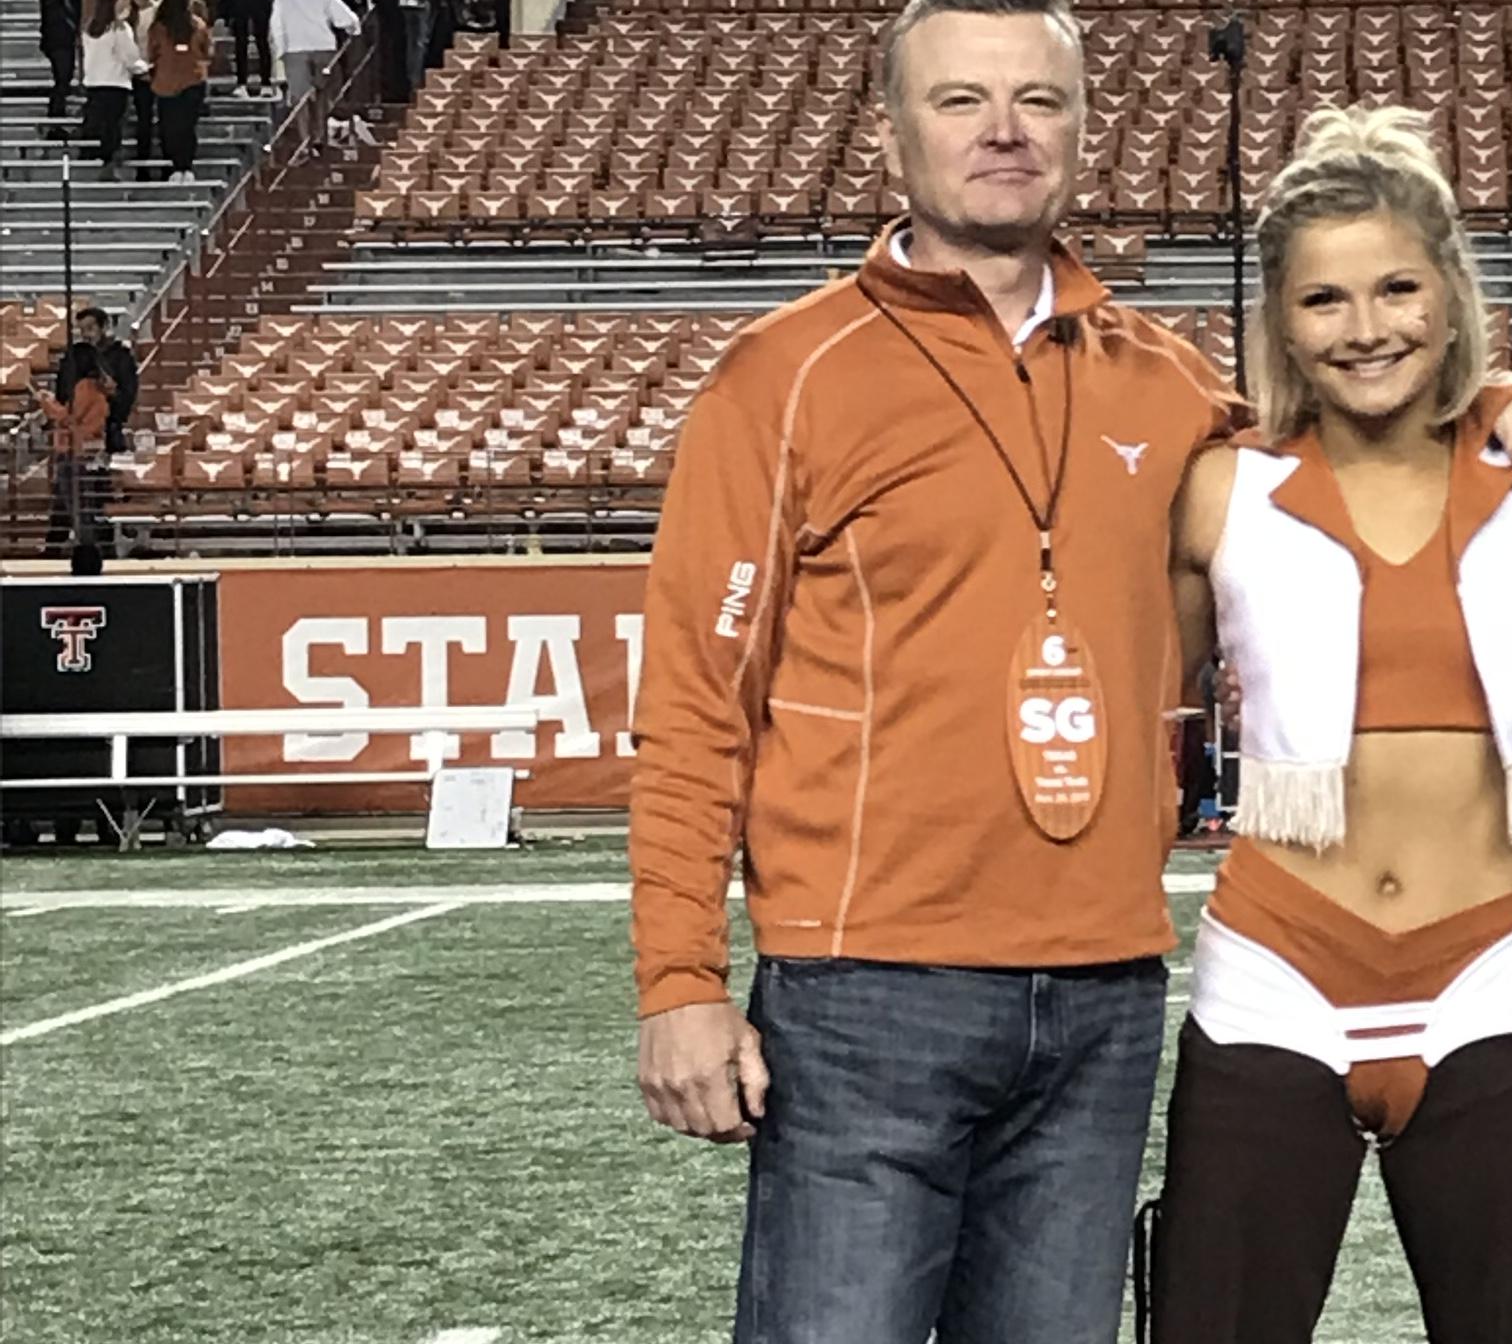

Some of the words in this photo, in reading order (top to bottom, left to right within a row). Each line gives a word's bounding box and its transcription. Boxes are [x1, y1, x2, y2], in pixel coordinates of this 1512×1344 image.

[714, 560, 757, 638] PING
[1041, 635, 1066, 666] 6
[282, 616, 646, 762] STA
[1019, 696, 1096, 743] SG
